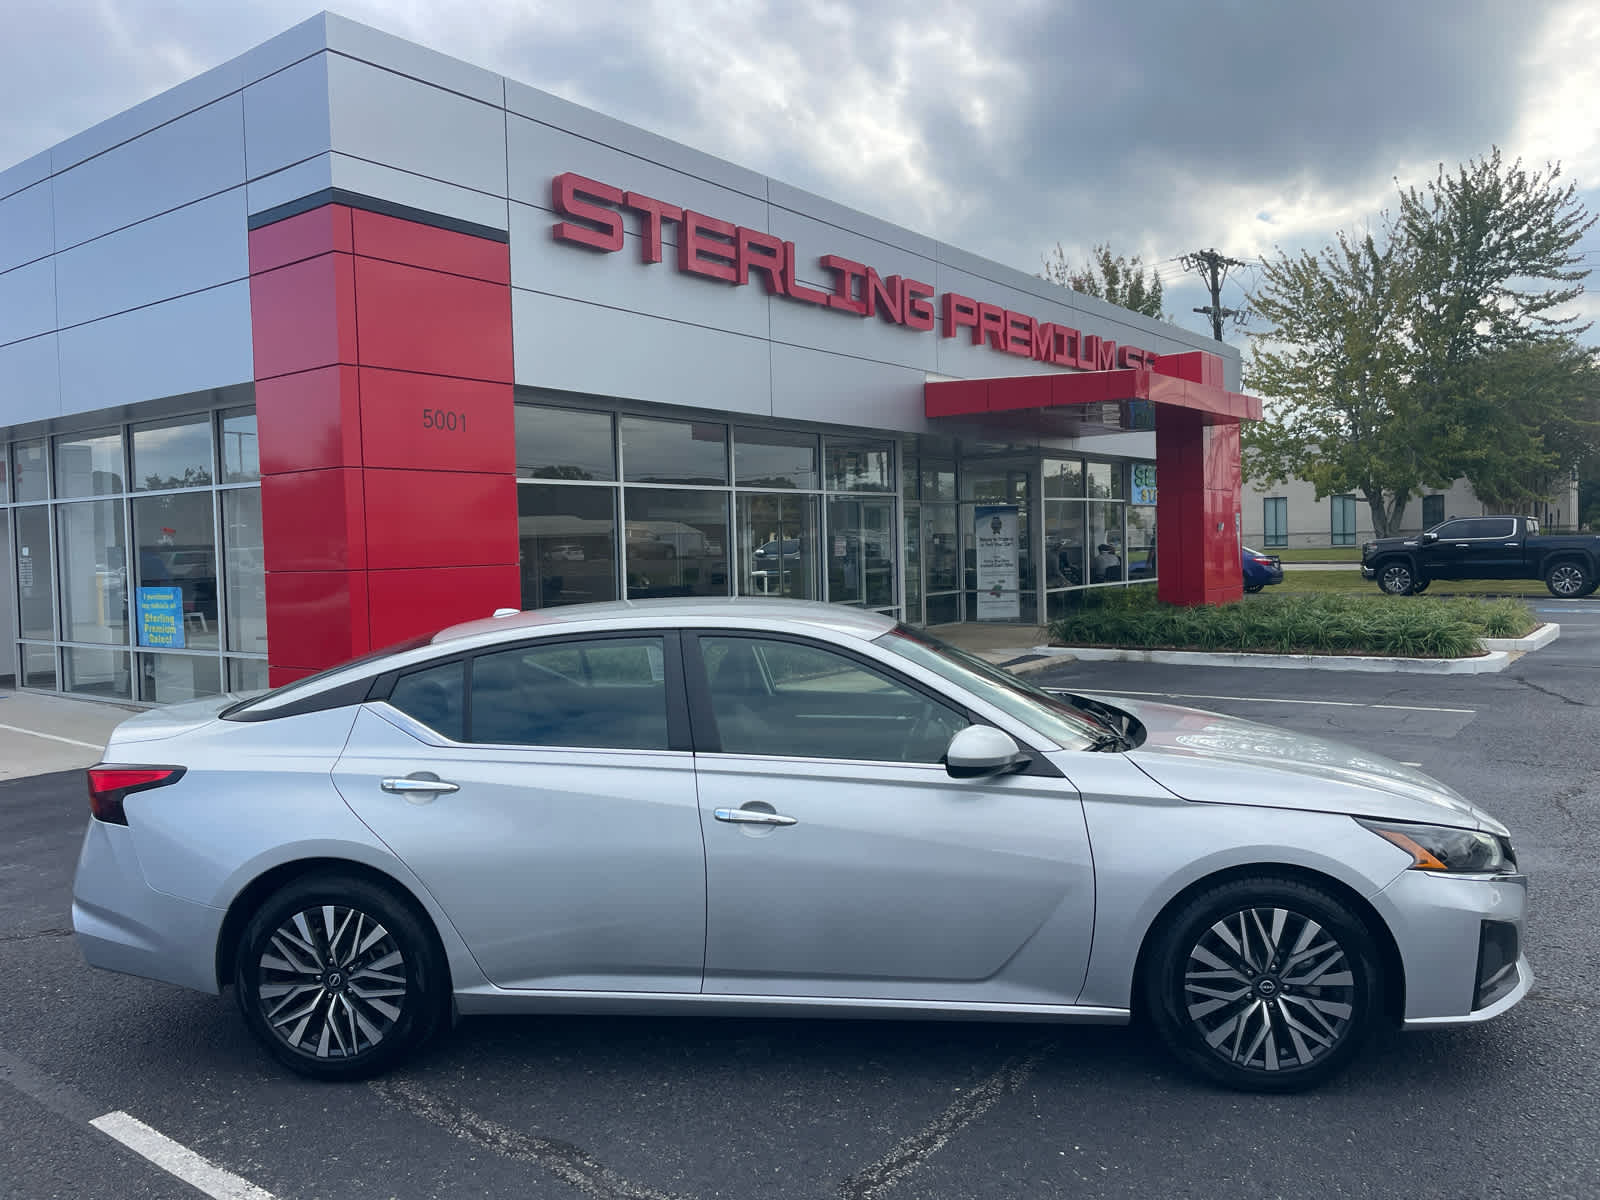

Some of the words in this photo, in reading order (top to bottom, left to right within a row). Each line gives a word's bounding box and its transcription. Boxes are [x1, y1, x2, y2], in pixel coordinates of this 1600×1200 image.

[552, 172, 935, 331] STERLING
[942, 292, 1117, 372] PREMIUM
[423, 409, 466, 432] 5001
